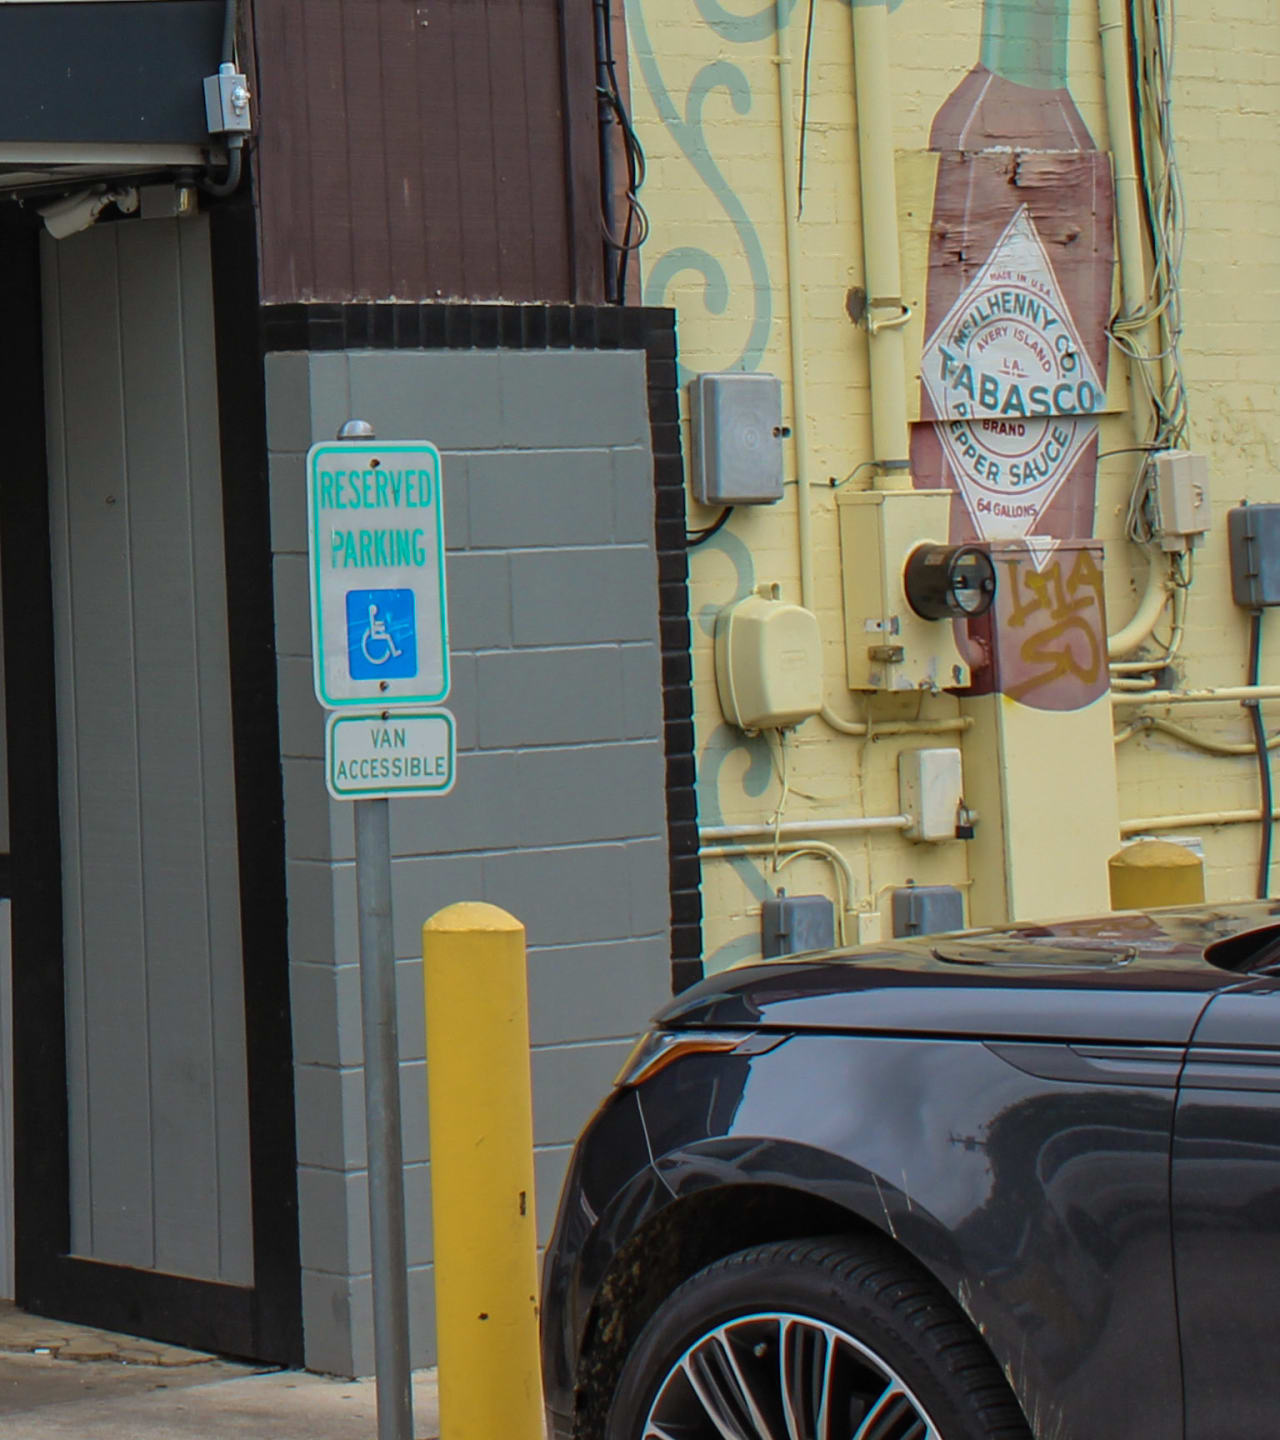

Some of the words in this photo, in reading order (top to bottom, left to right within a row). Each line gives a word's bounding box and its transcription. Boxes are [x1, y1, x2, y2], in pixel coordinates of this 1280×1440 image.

[1016, 273, 1028, 283] IN
[975, 325, 1009, 353] AVERY
[1013, 329, 1052, 373] ISLAND
[938, 345, 1096, 418] TABASCO
[949, 401, 1002, 485] PEPPER
[1008, 425, 1069, 487] SAUCE
[982, 419, 1026, 438] BRAND
[320, 469, 432, 510] RESERVED
[976, 498, 992, 514] 64
[993, 502, 1038, 519] GALLONS
[331, 527, 427, 570] PARKING
[370, 727, 406, 749] VAN
[336, 754, 447, 781] ACCESSIBLE
